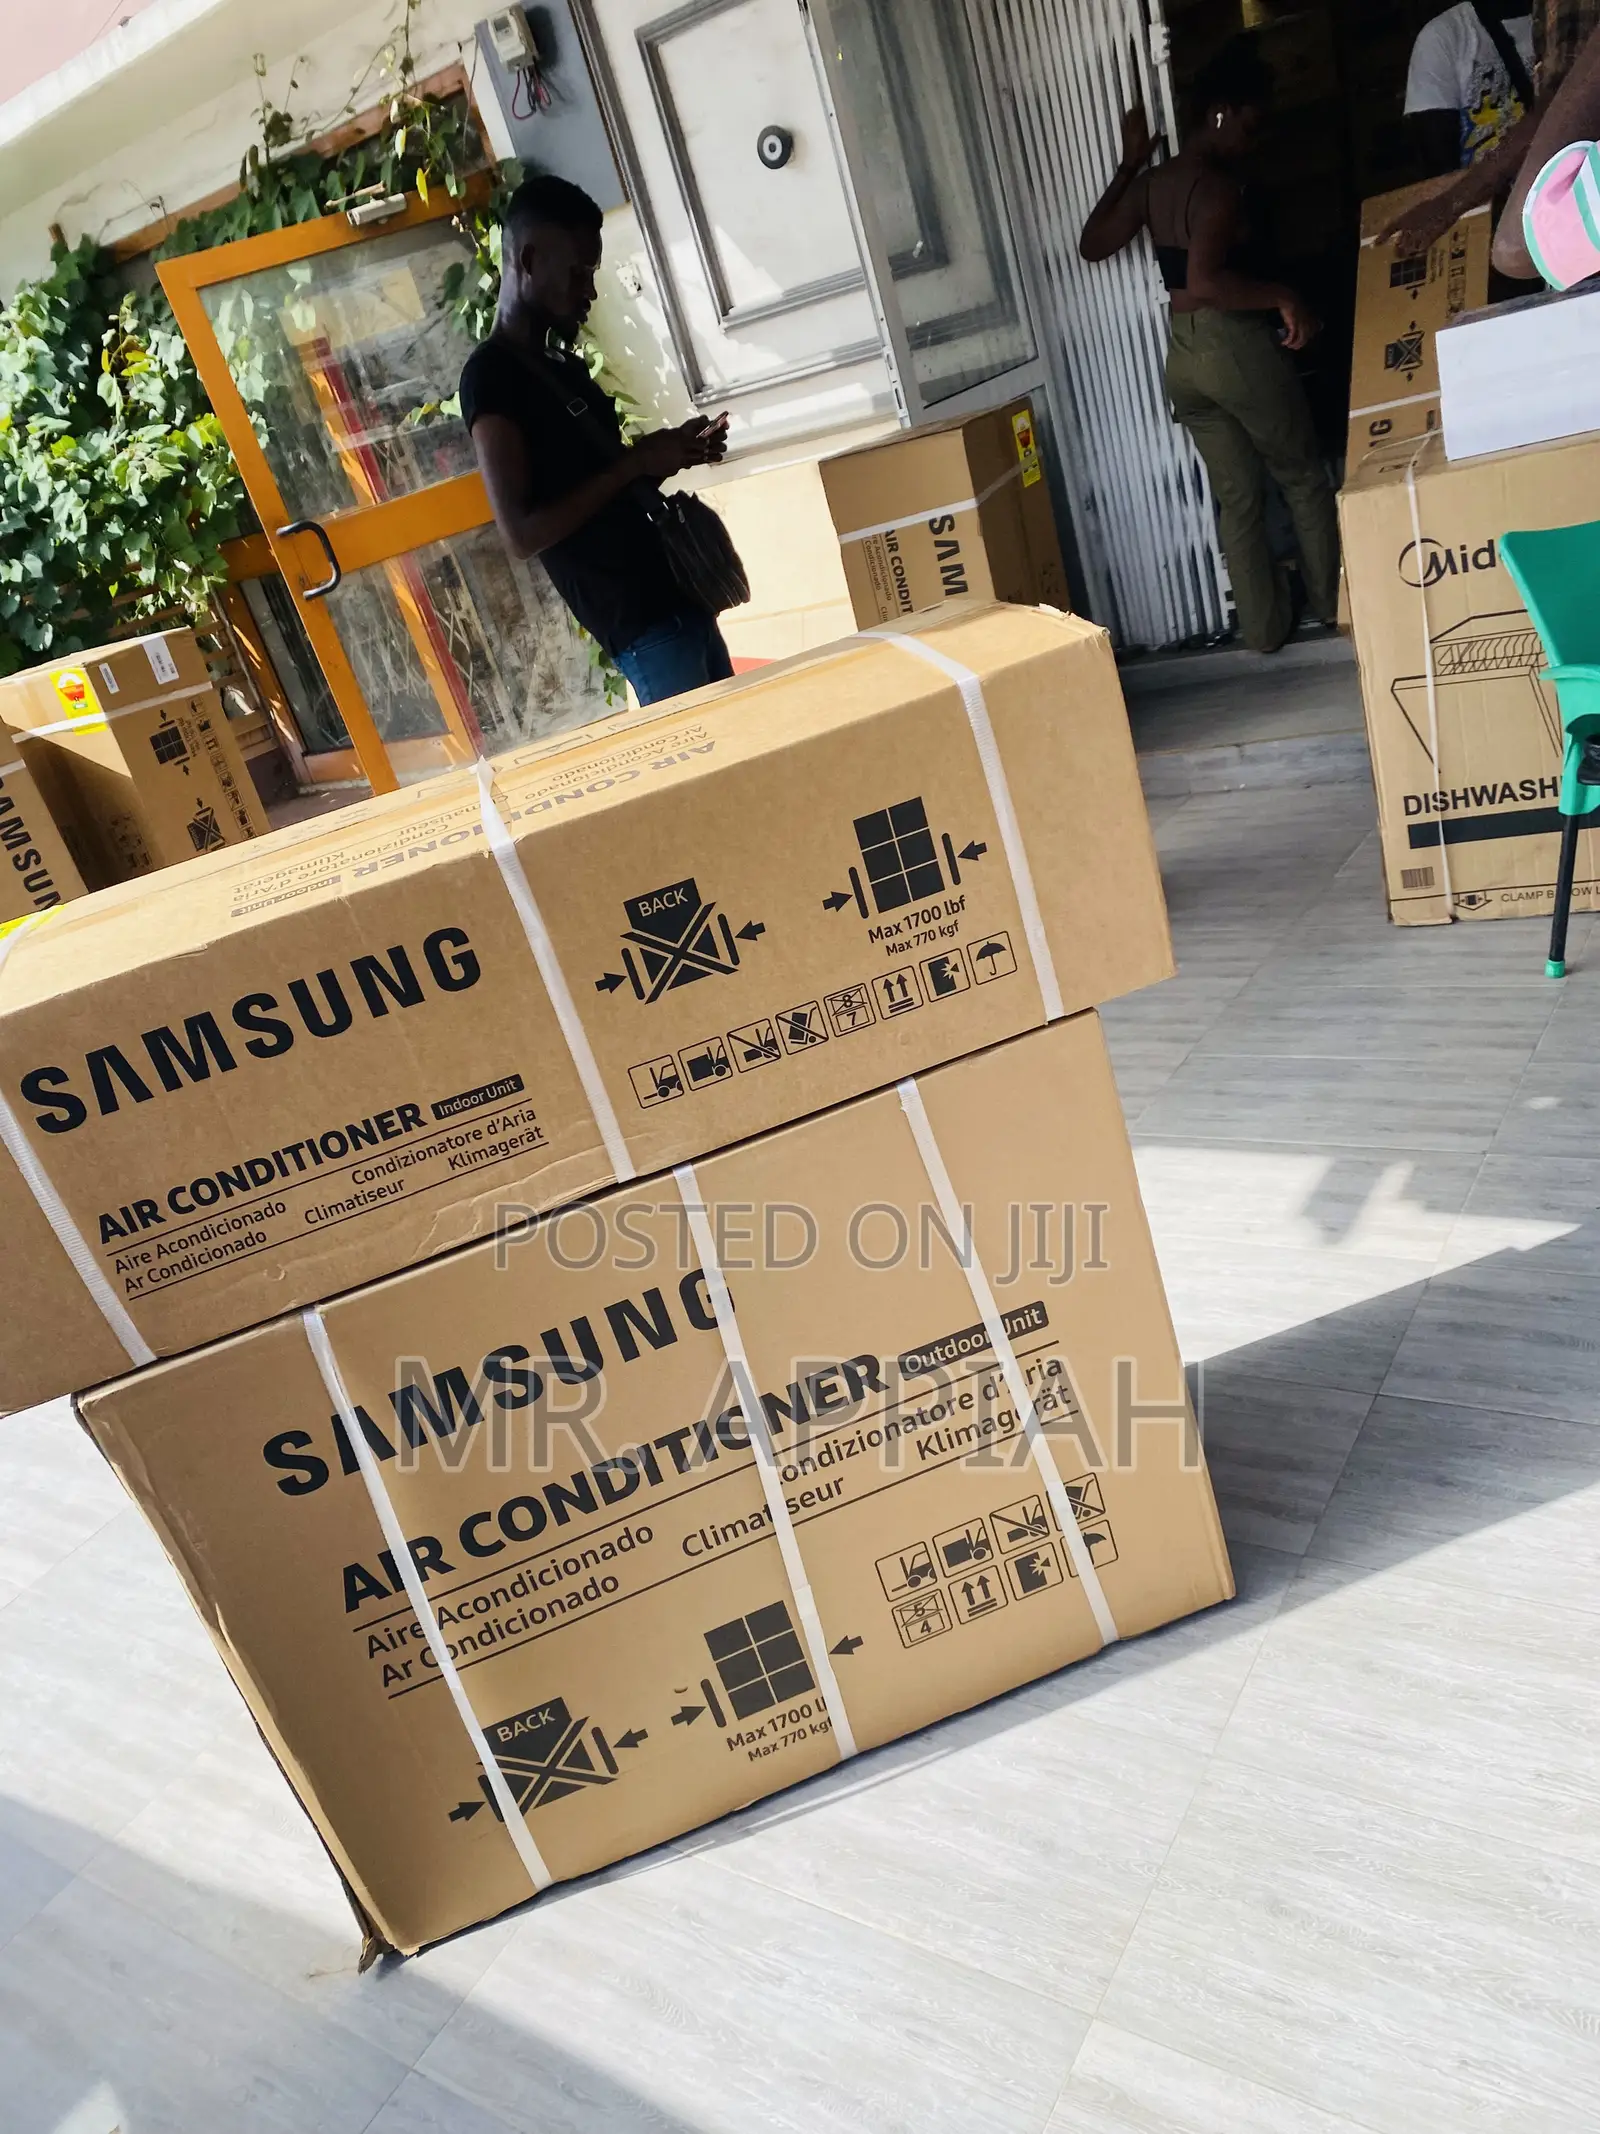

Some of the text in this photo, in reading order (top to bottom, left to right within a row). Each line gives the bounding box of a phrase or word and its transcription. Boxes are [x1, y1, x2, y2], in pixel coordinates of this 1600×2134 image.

[1398, 538, 1499, 587] Mid
[552, 734, 679, 781] Condicionado
[650, 740, 716, 770] AIR
[671, 731, 708, 748] Aire
[524, 746, 670, 800] Acondicionado
[1403, 775, 1563, 816] DISHWASH
[0, 776, 61, 911] AMSUN
[353, 769, 641, 878] CONDIIONER
[297, 822, 449, 879] Condizionatore
[637, 887, 689, 917] BACK
[868, 894, 966, 943] Max 1700 lbf
[1501, 890, 1543, 902] CLAMP
[1546, 886, 1592, 899] BOW
[885, 919, 959, 956] Max 770 kgf
[20, 927, 481, 1134] SAMSUNG
[846, 1011, 857, 1026] 7
[99, 1080, 518, 1244] AIR CONDITIONER Indoor Unit
[115, 1250, 153, 1275] Aire
[156, 1201, 287, 1260] Acondicionado
[351, 1128, 483, 1186] Condizionatore
[124, 1125, 544, 1293] Ar Condicionado Climatiseur Klimagerät
[263, 1268, 735, 1496] SAMSUNG
[342, 1535, 457, 1614] AIR
[458, 1354, 890, 1557] CONDITIONER
[367, 1357, 1063, 1659] Aire Acondicionado ondizionatore d'ria
[382, 1659, 413, 1688] Ar
[419, 1575, 620, 1669] Condicionado
[682, 1476, 844, 1557] Climatseur
[920, 1619, 932, 1634] 4
[496, 1707, 556, 1743] BACK
[726, 1726, 768, 1752] Max
[767, 1703, 813, 1733] 1700
[747, 1742, 780, 1762] Max
[779, 1728, 808, 1748] 770
